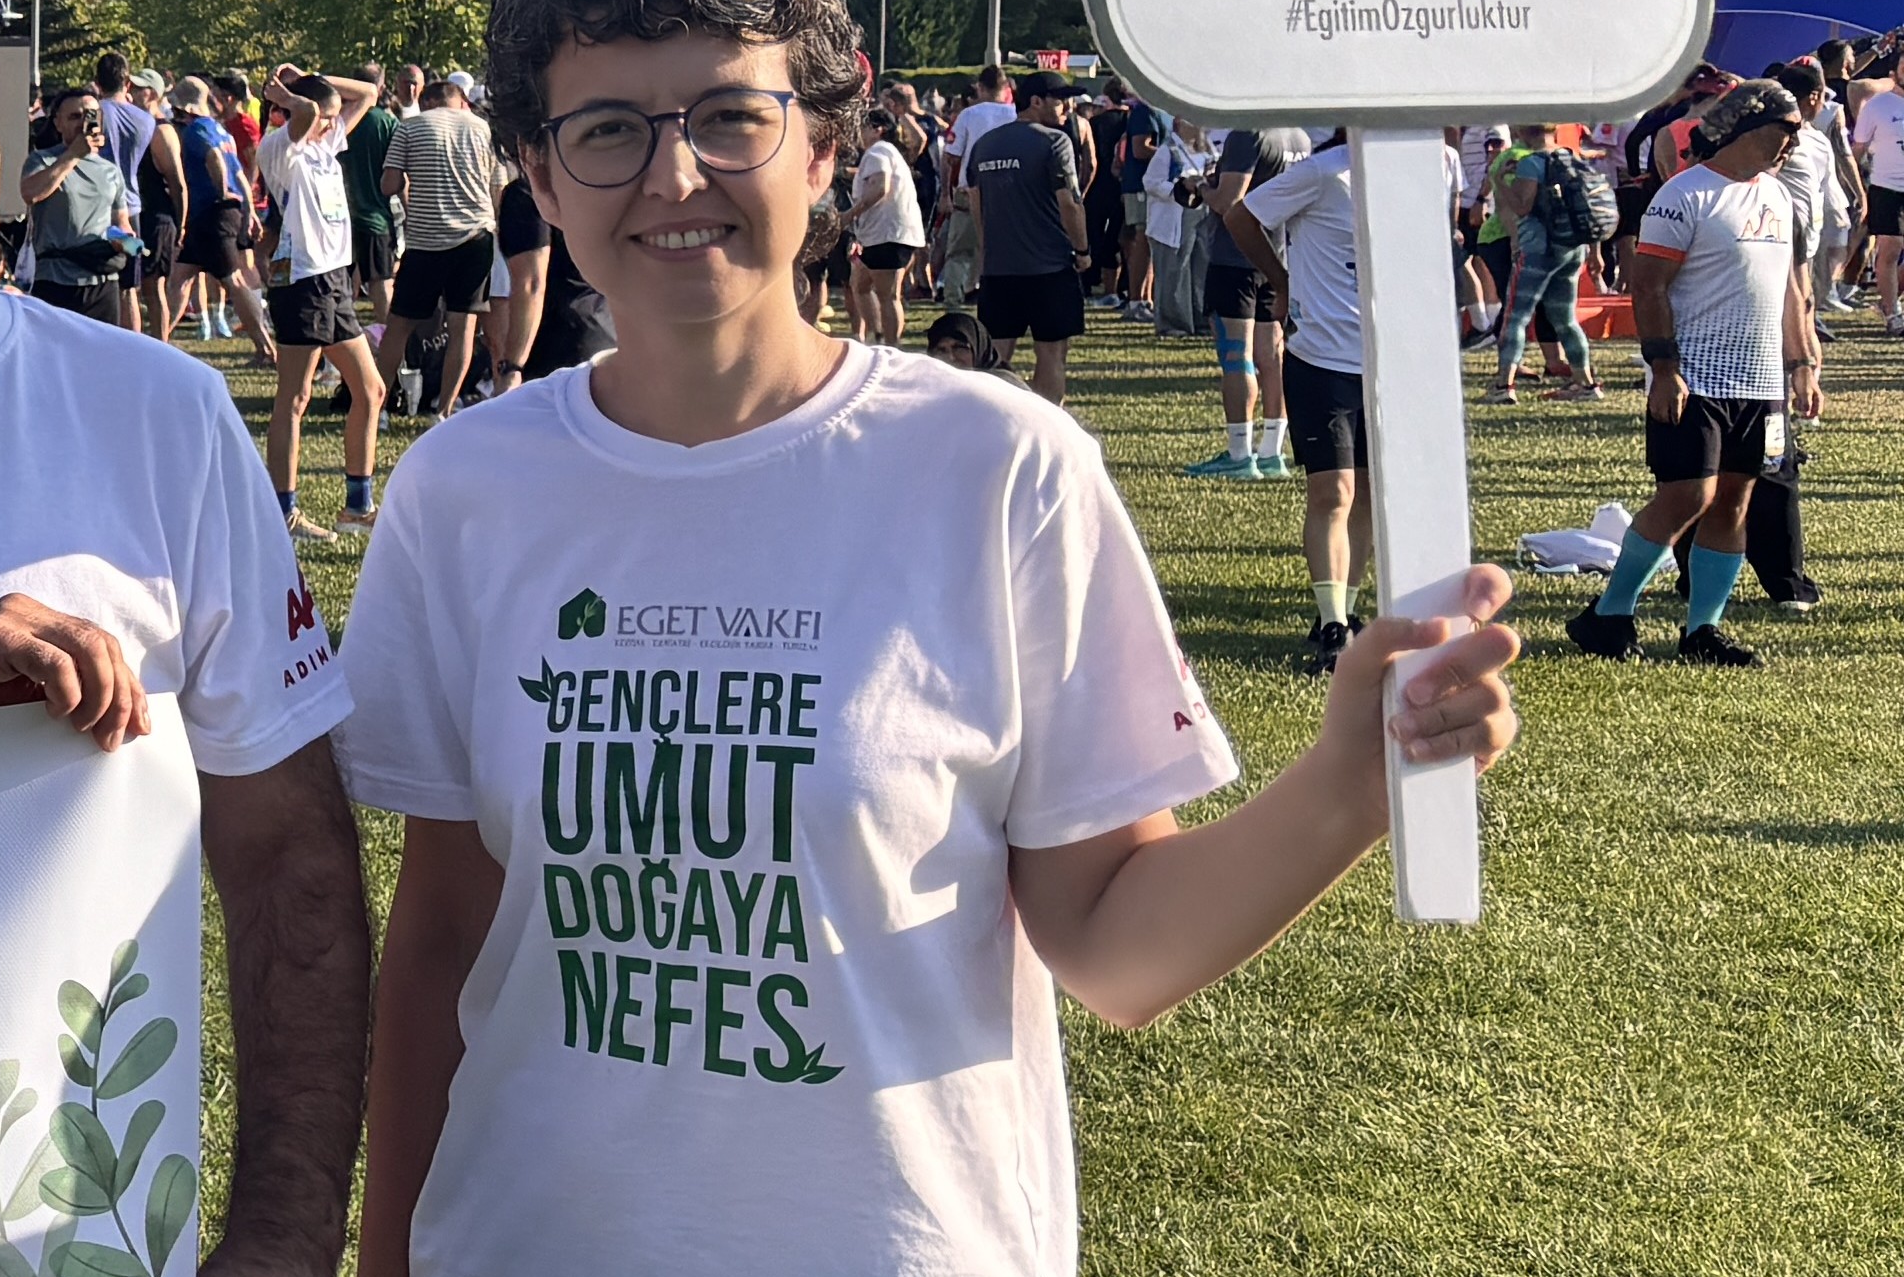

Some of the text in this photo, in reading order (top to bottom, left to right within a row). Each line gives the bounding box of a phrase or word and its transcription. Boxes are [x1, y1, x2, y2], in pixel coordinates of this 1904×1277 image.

[617, 605, 822, 639] EGET VAKFI
[547, 669, 822, 745] GENÇLERE
[542, 741, 814, 862] UMUT
[543, 857, 809, 963] DOĞAYA
[557, 949, 809, 1084] NEFES
